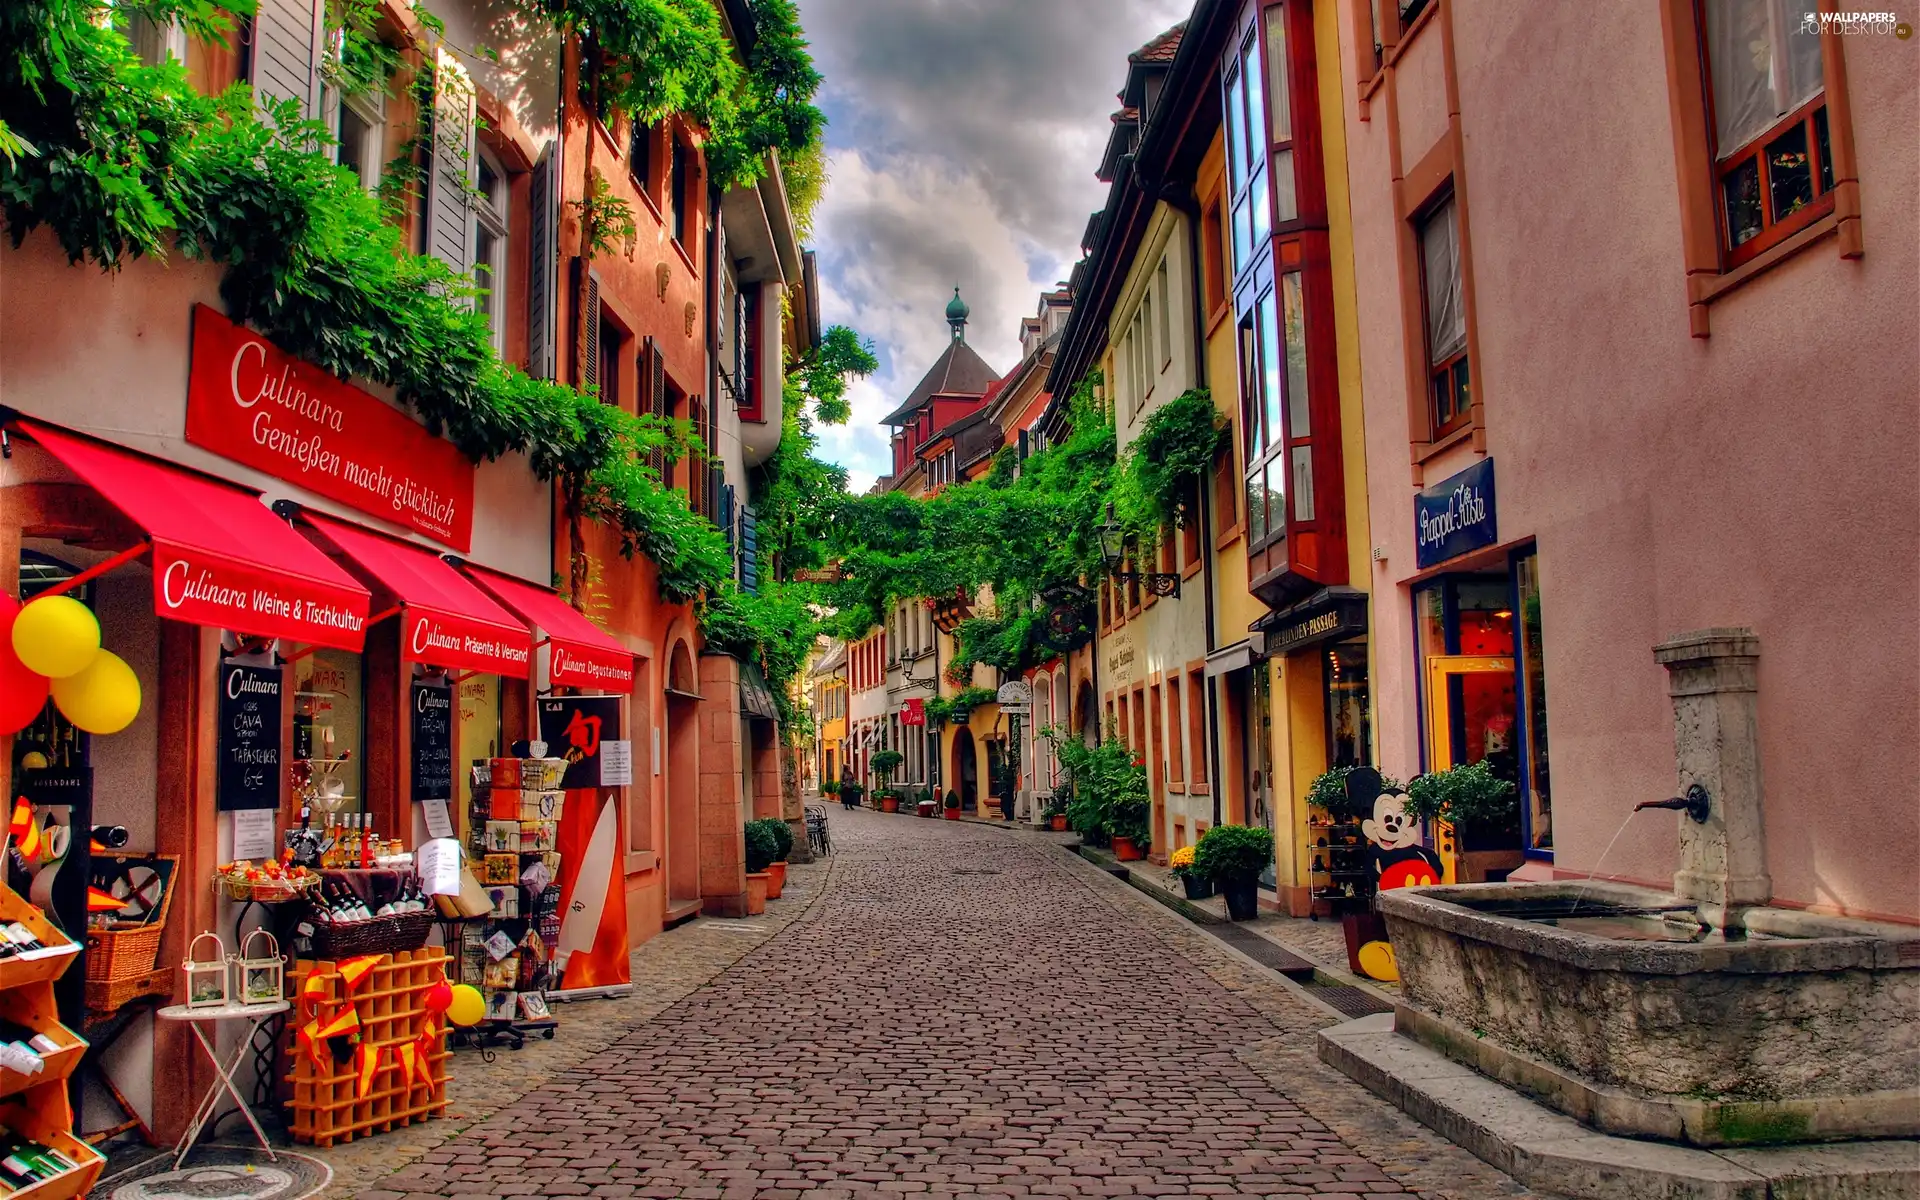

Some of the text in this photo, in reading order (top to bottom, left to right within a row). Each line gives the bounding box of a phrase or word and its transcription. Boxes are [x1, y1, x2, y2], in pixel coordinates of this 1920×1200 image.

[231, 341, 343, 432] Culinara
[253, 411, 455, 526] Genießen macht glücklich
[164, 560, 363, 631] Culinara Weine & Tischkultur
[412, 617, 528, 663] Culinara Präsente & Versand
[554, 648, 632, 681] Culinara Degustationen
[228, 669, 278, 699] Culinara
[418, 688, 449, 713] Culinara
[233, 712, 263, 730] CAVA
[546, 702, 563, 711] KAI
